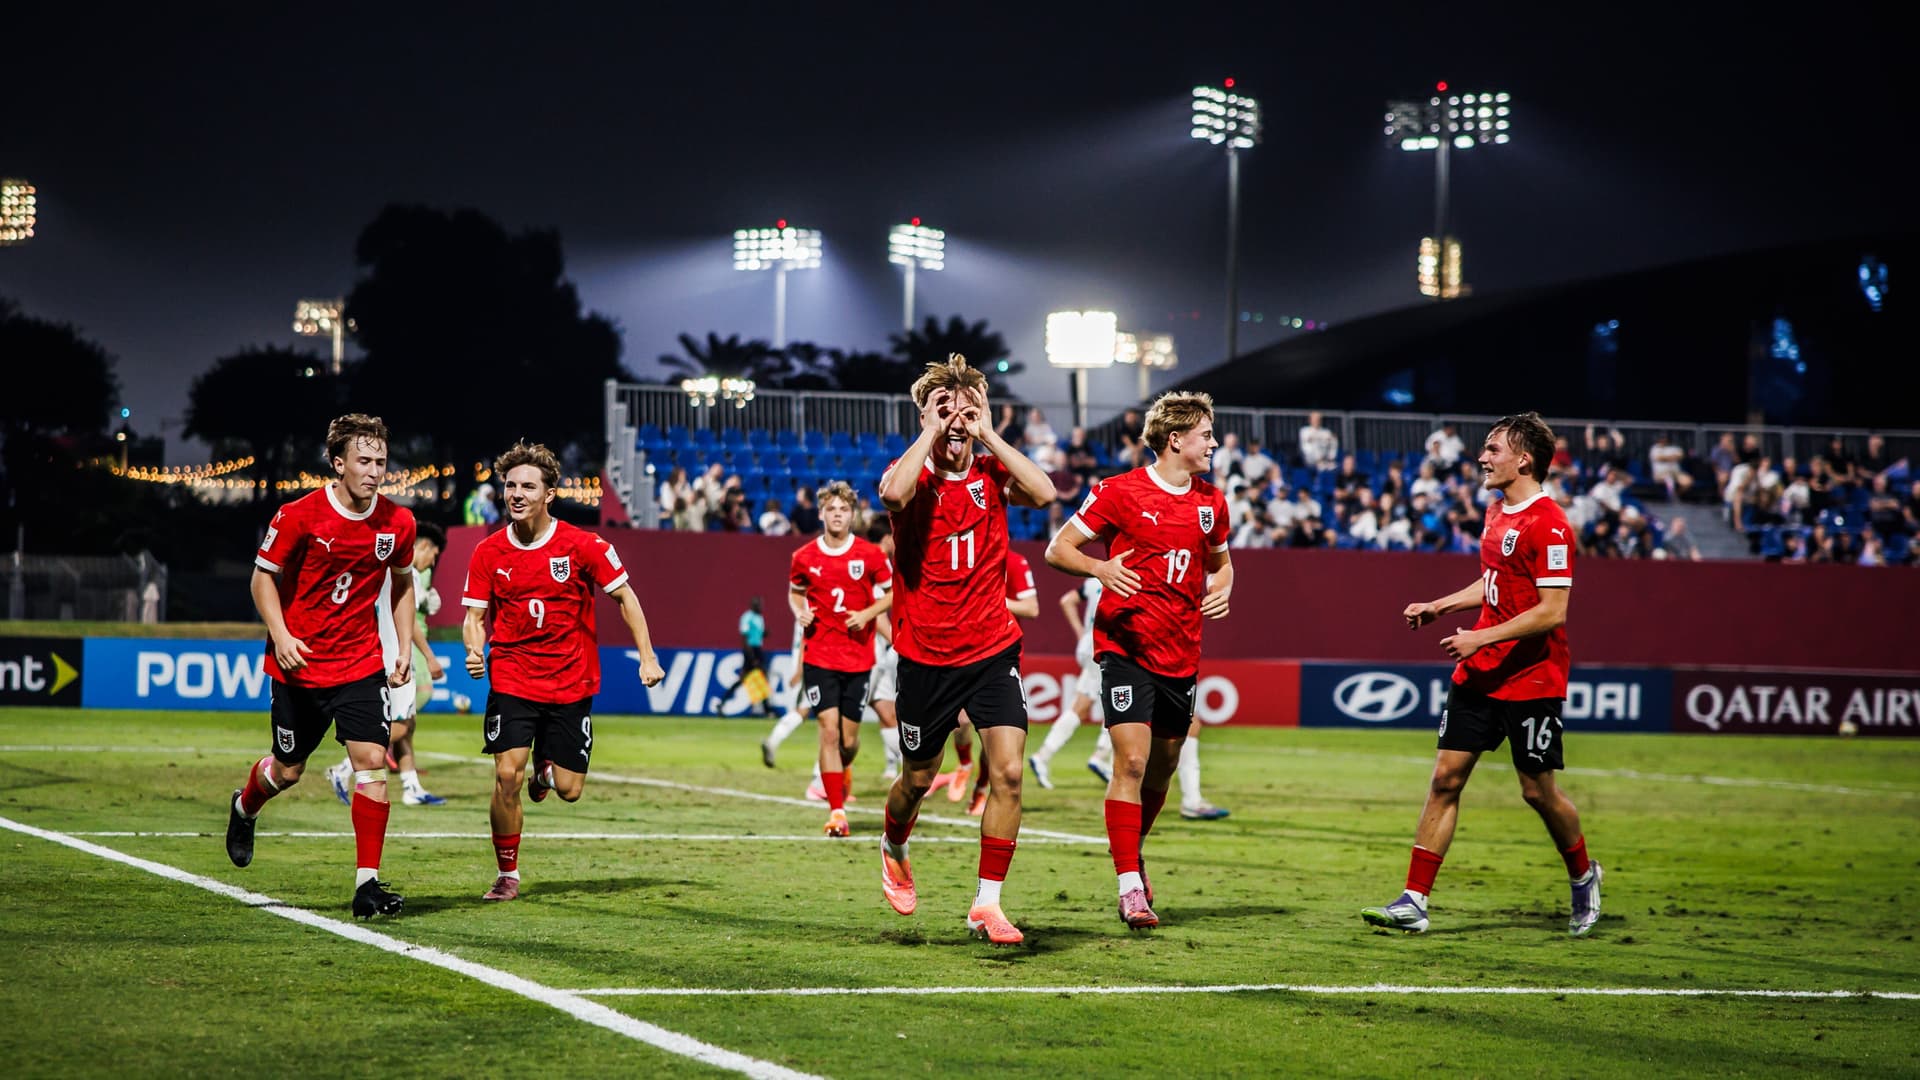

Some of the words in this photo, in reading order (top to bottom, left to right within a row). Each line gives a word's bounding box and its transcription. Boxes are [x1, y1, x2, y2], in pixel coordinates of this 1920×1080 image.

[946, 530, 975, 570] 11
[1163, 549, 1191, 584] 19
[331, 572, 352, 604] 8
[831, 588, 847, 613] 2
[1483, 568, 1499, 606] 16
[528, 598, 545, 629] 9
[625, 651, 803, 715] VISA
[380, 686, 391, 721] 8
[1686, 684, 1830, 730] QATAR
[581, 716, 592, 748] 9
[1521, 716, 1553, 750] 16
